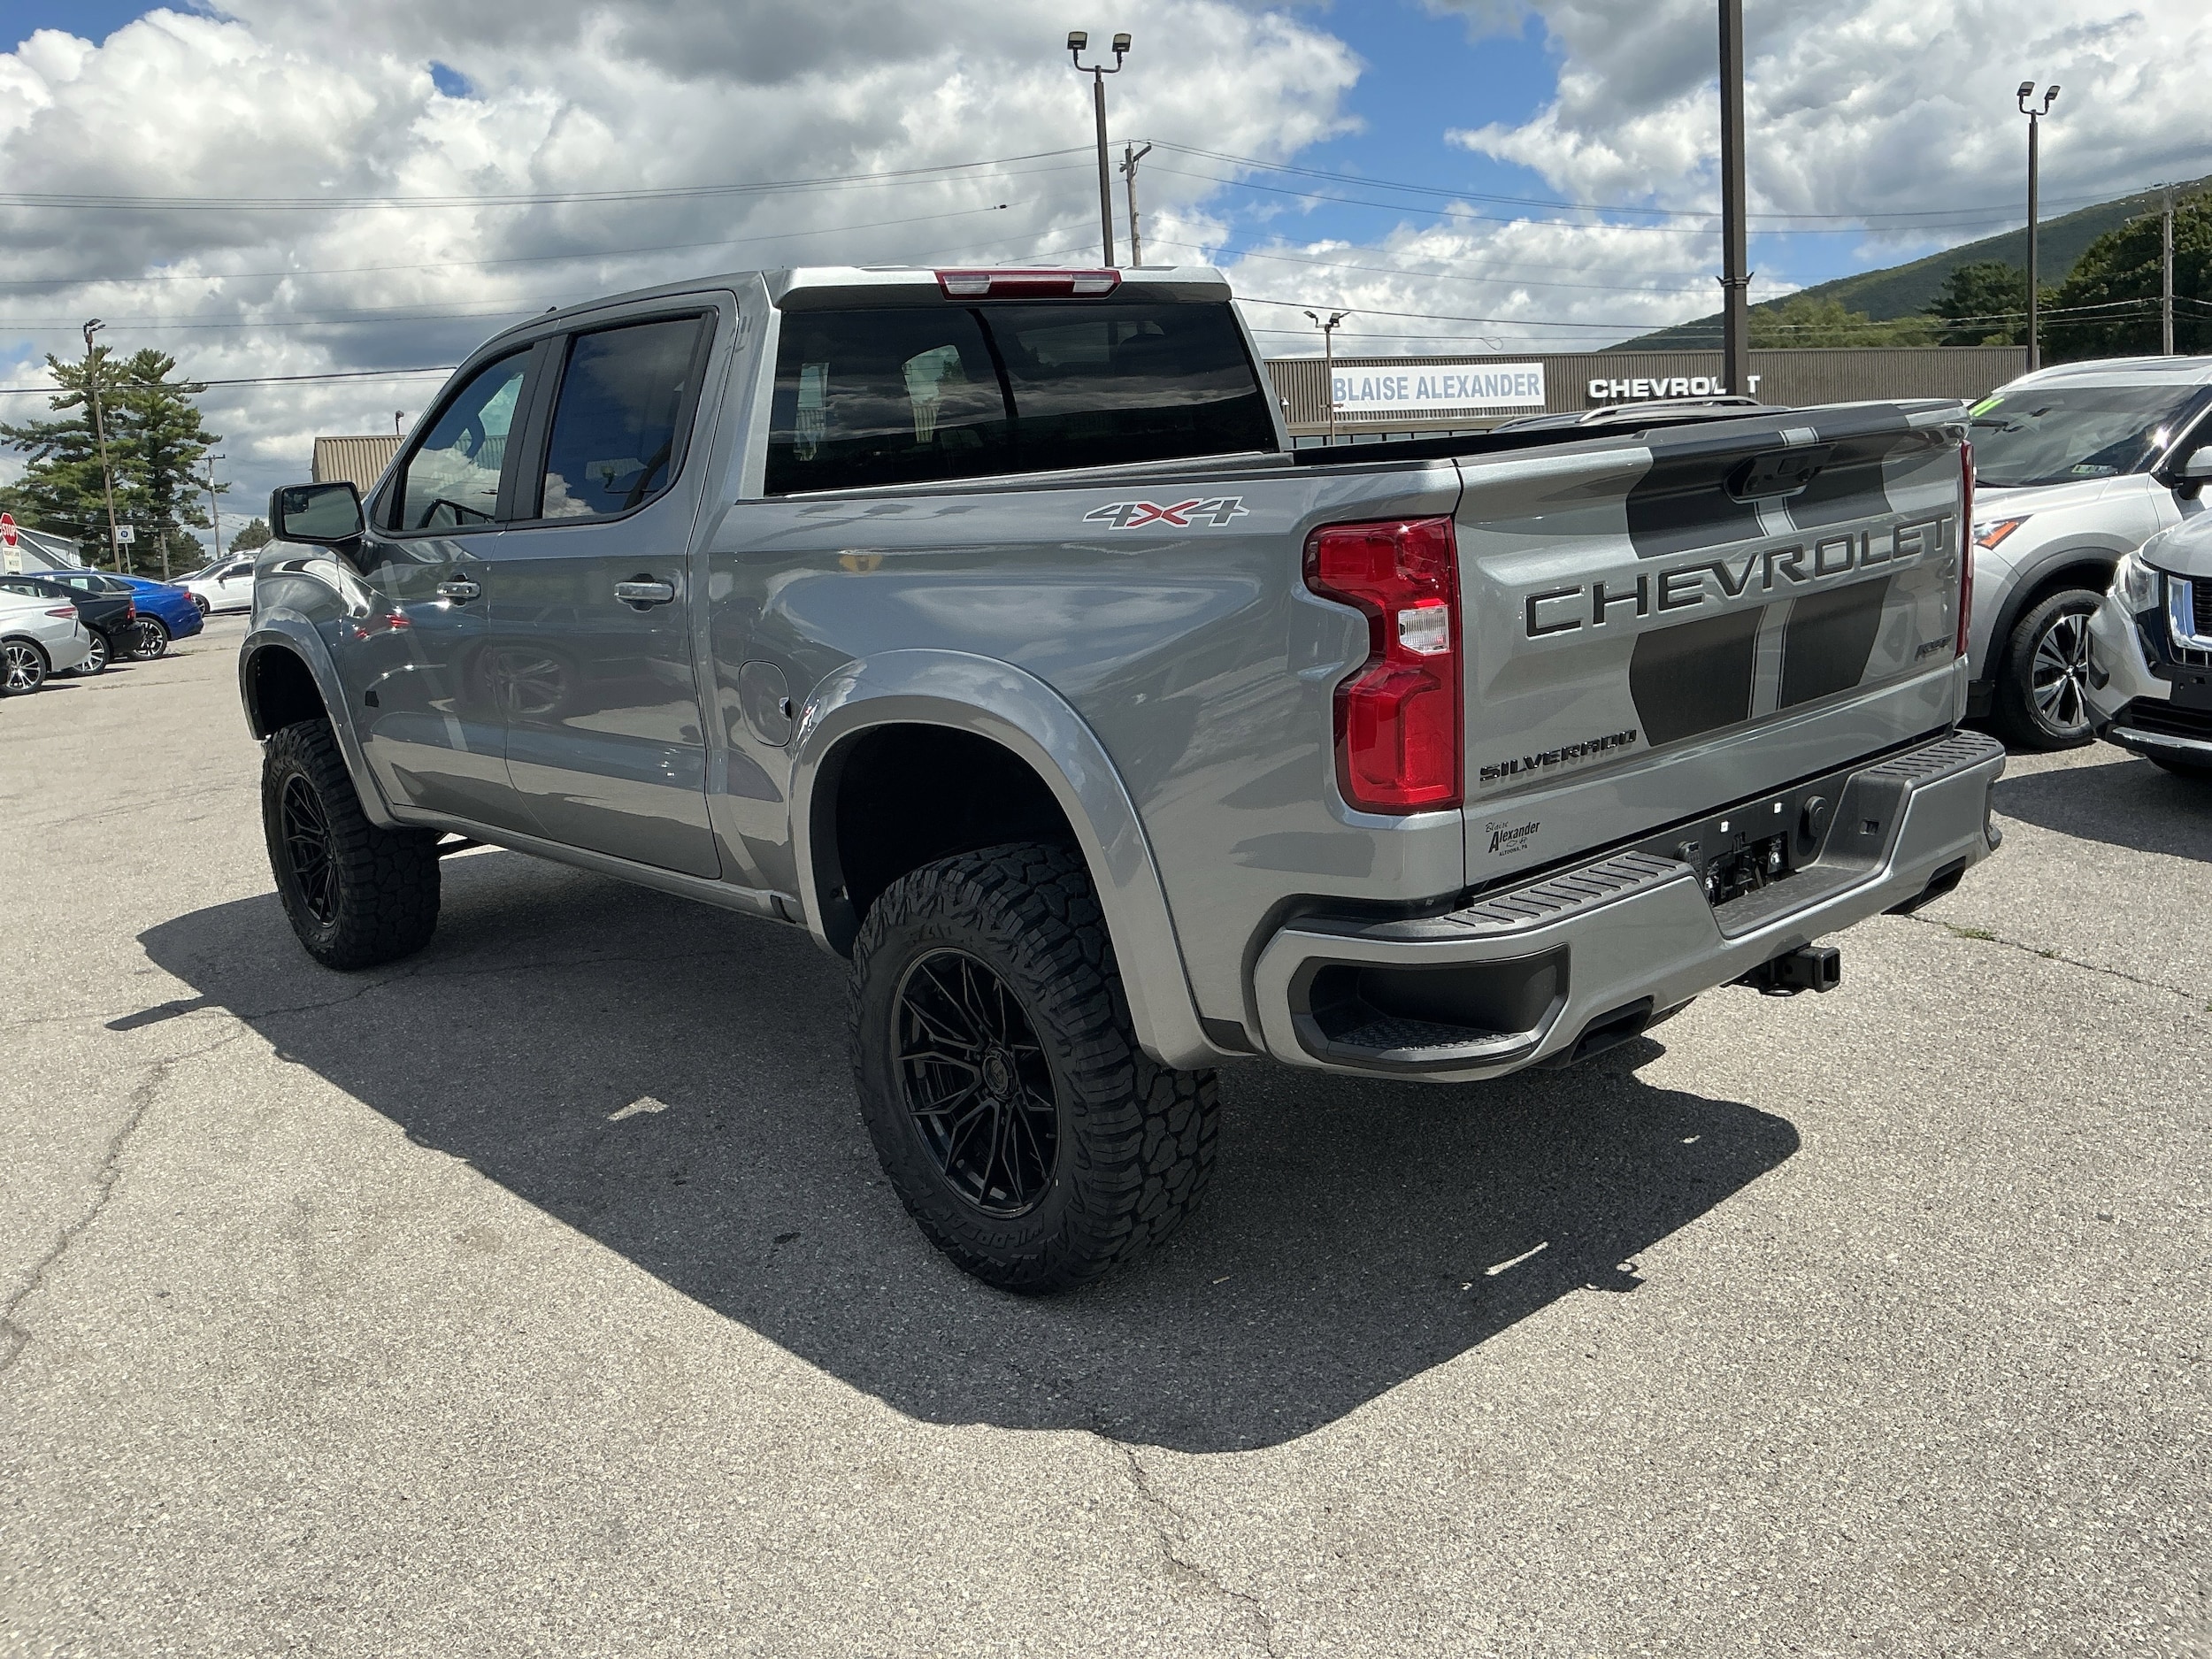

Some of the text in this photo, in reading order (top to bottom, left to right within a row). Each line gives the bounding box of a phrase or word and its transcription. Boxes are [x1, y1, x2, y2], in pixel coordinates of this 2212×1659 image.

[1333, 373, 1540, 401] BLAISE ALEXANDER
[1588, 375, 1761, 398] CHEVROLT
[2, 523, 16, 537] STOP
[1525, 513, 1955, 639] CHEVROLET
[1479, 729, 1637, 781] SILVERADO
[1488, 821, 1540, 854] Alexander
